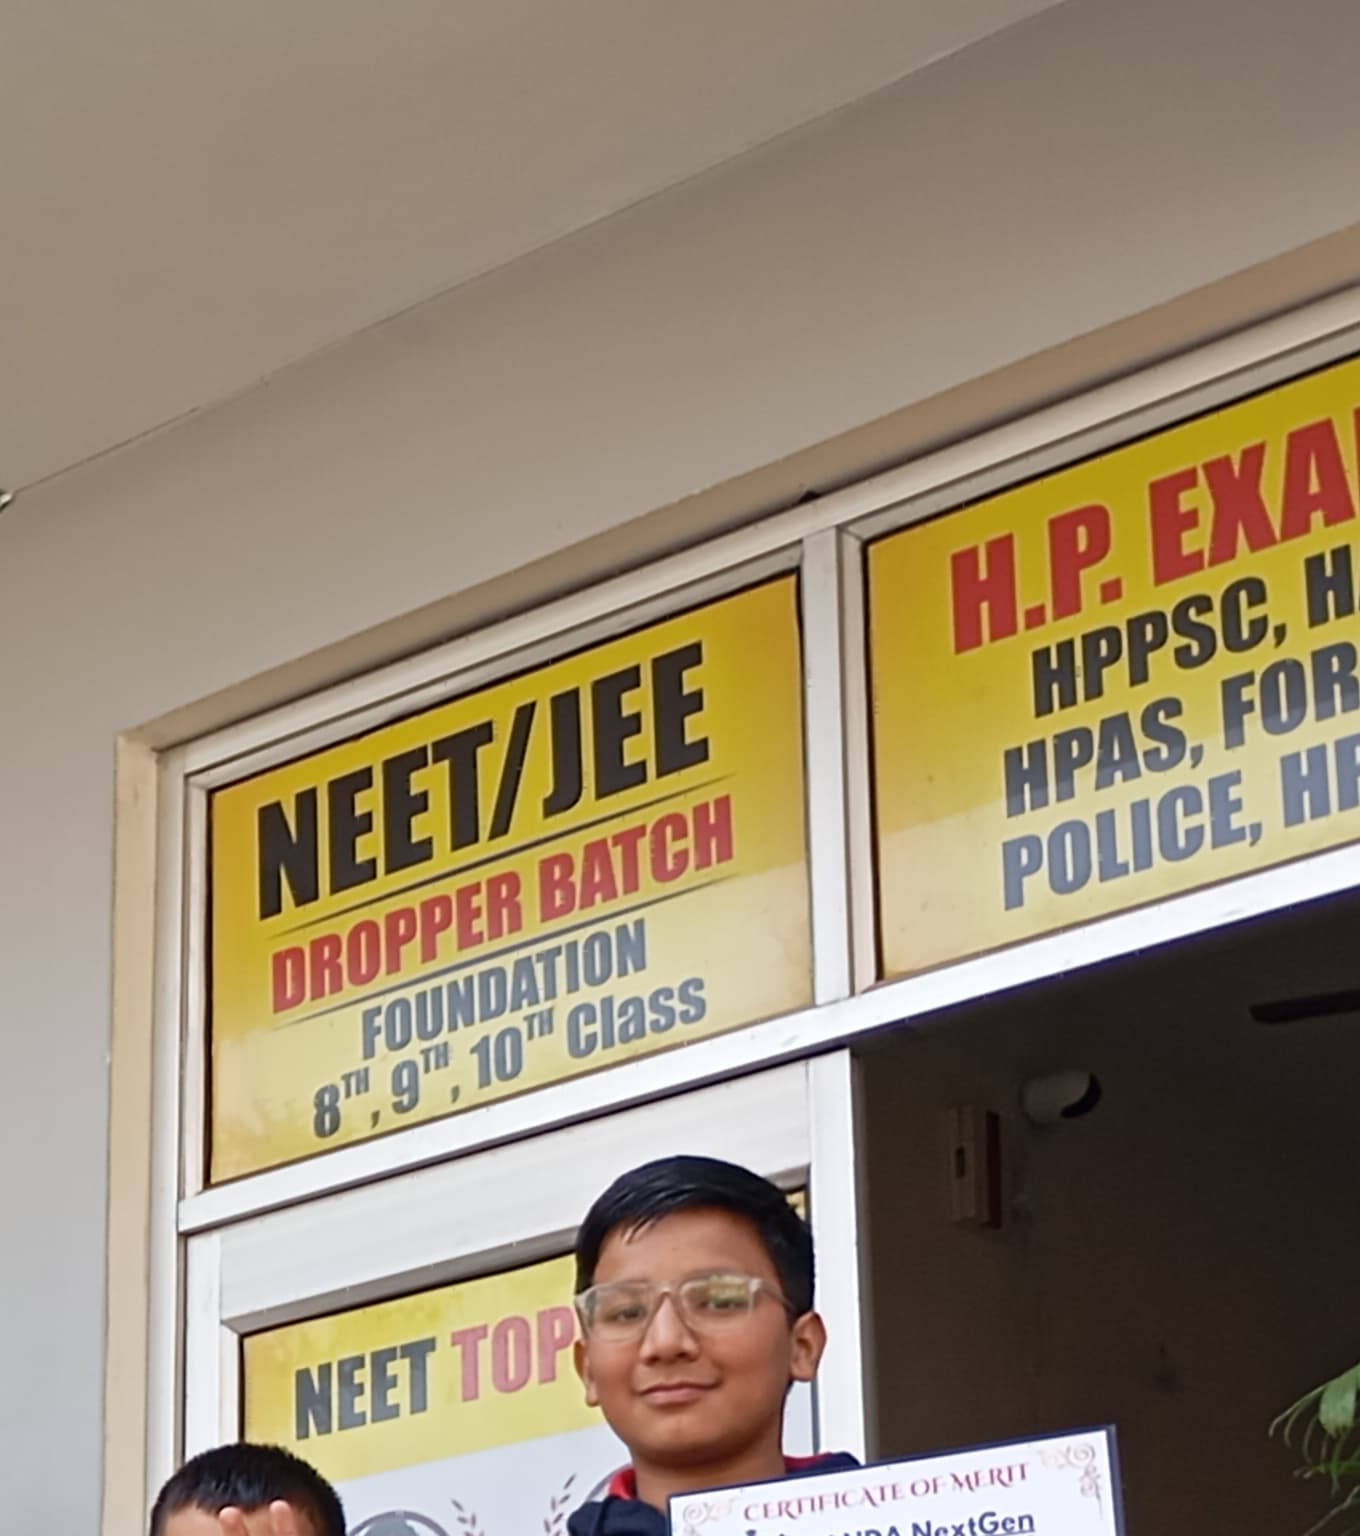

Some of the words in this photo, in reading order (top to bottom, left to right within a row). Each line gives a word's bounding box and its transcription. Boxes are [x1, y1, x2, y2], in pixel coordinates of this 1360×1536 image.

[951, 503, 1123, 656] H.P.
[1148, 406, 1360, 588] EXA
[1032, 576, 1287, 719] HPPSC,
[1304, 543, 1360, 629] H
[258, 639, 710, 921] NEET/JEE
[1004, 696, 1205, 819] HPAS,
[271, 871, 522, 1014] DROPPER
[539, 793, 734, 924] BATCH
[1002, 759, 1263, 911] POLICE,
[362, 917, 647, 1060] FOUNDATION
[567, 976, 707, 1060] Class
[295, 1336, 437, 1441] NEET
[743, 1482, 904, 1521] CERTIFICATE
[910, 1476, 944, 1497] OF
[949, 1463, 1029, 1493] MERIT
